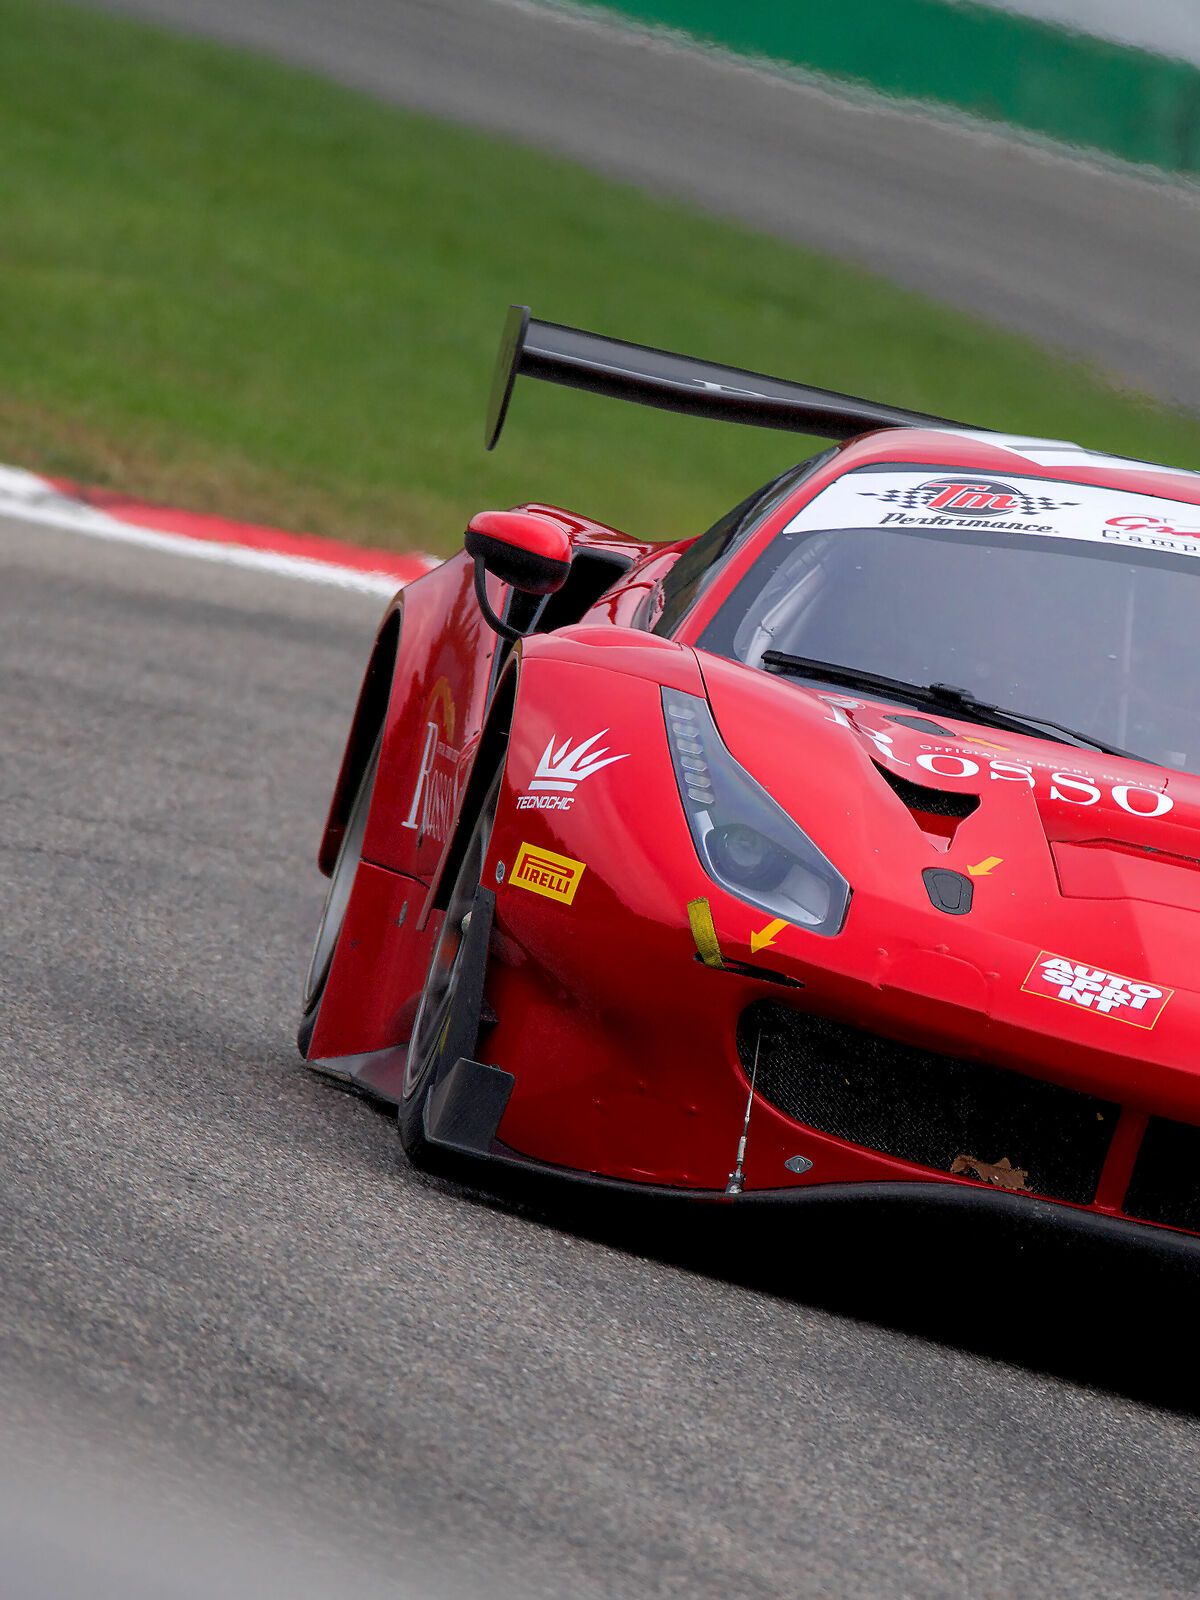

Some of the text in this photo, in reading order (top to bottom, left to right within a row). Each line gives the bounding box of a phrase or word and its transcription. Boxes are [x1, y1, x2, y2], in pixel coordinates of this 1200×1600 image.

[879, 512, 1054, 533] Performance
[919, 744, 999, 760] OFFICIAL
[516, 795, 575, 811] TECNOCHIC
[516, 852, 576, 894] PIRELLI
[1039, 957, 1163, 1000] AUTO
[1041, 968, 1148, 1010] SPRI
[1057, 986, 1121, 1013] NT
